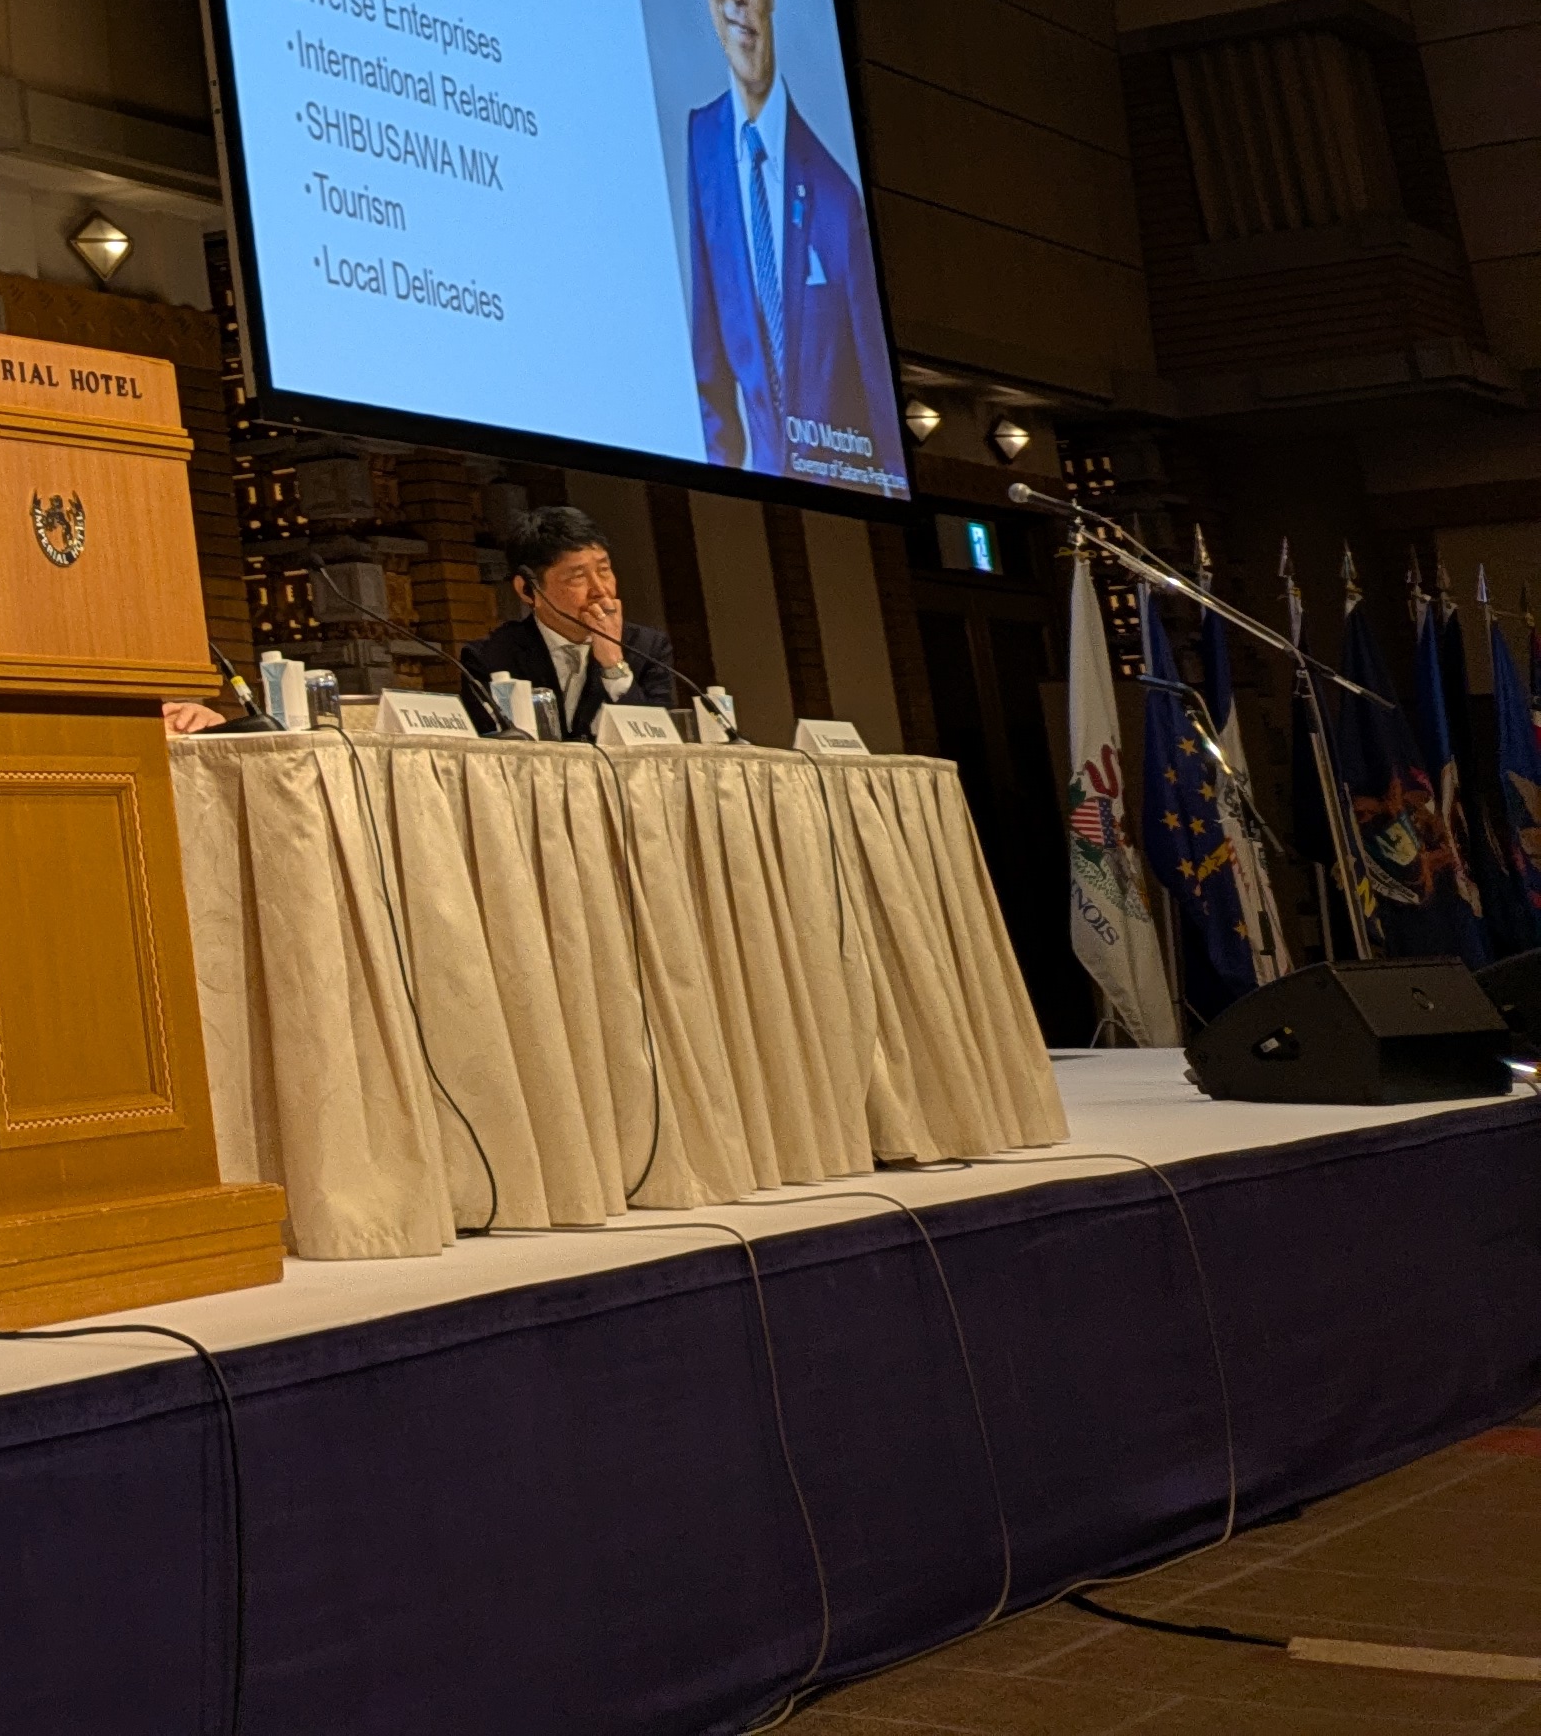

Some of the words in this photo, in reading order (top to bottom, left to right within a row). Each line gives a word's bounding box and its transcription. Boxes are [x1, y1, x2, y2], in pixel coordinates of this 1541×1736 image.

[296, 29, 437, 107] International
[441, 74, 538, 137] Relations
[306, 101, 457, 178] SHIBUSAWA
[458, 144, 503, 191] MIX
[312, 171, 406, 231] Tourism
[322, 244, 387, 296] Local
[392, 260, 505, 321] Delicacies
[70, 368, 143, 399] HOTEL
[399, 708, 418, 727] T.
